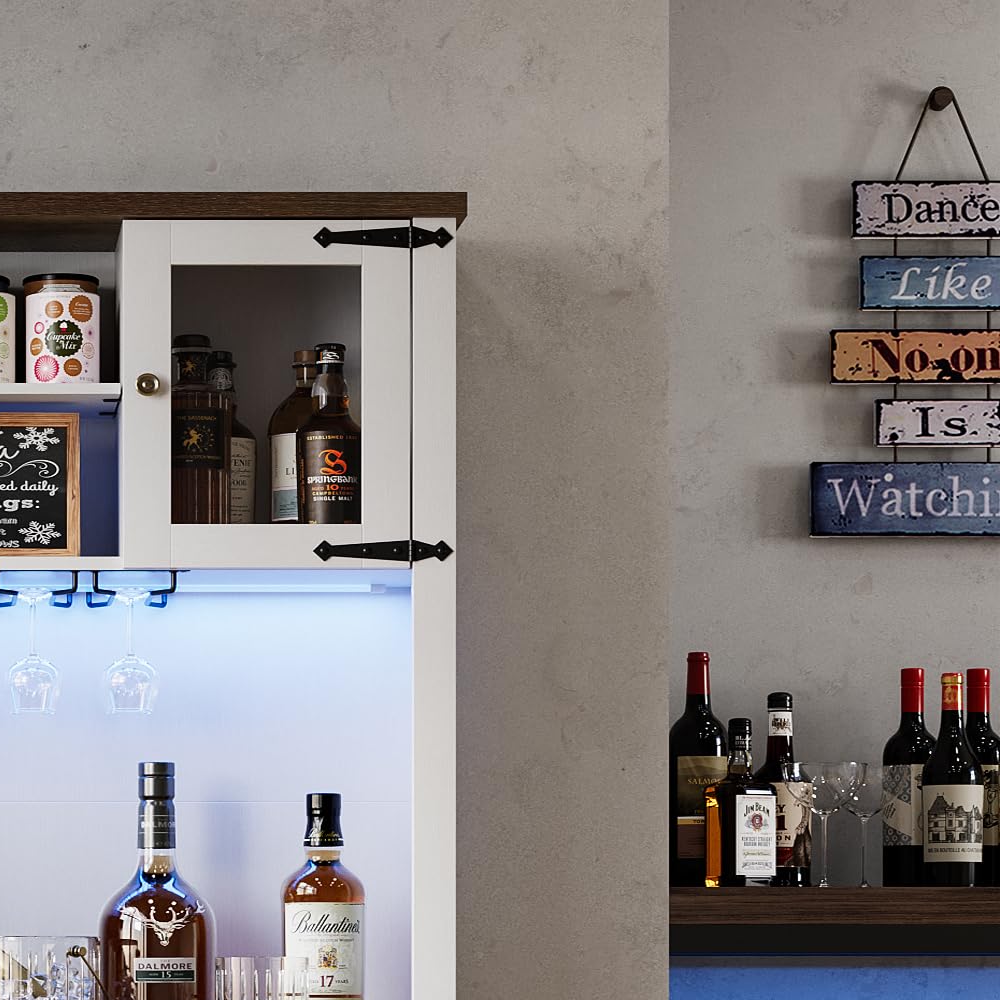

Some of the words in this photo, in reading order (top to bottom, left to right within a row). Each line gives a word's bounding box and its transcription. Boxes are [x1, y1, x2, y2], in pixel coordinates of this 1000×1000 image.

[882, 193, 1000, 223] Dance
[890, 263, 992, 301] Like
[46, 332, 81, 342] Cupcake
[58, 341, 78, 350] Mix
[867, 339, 929, 374] No
[914, 407, 967, 438] Is
[307, 475, 359, 484] SPRINGBANK
[20, 480, 59, 497] daily
[743, 804, 755, 817] JIM
[755, 802, 770, 817] BEAM
[319, 975, 334, 988] 17
